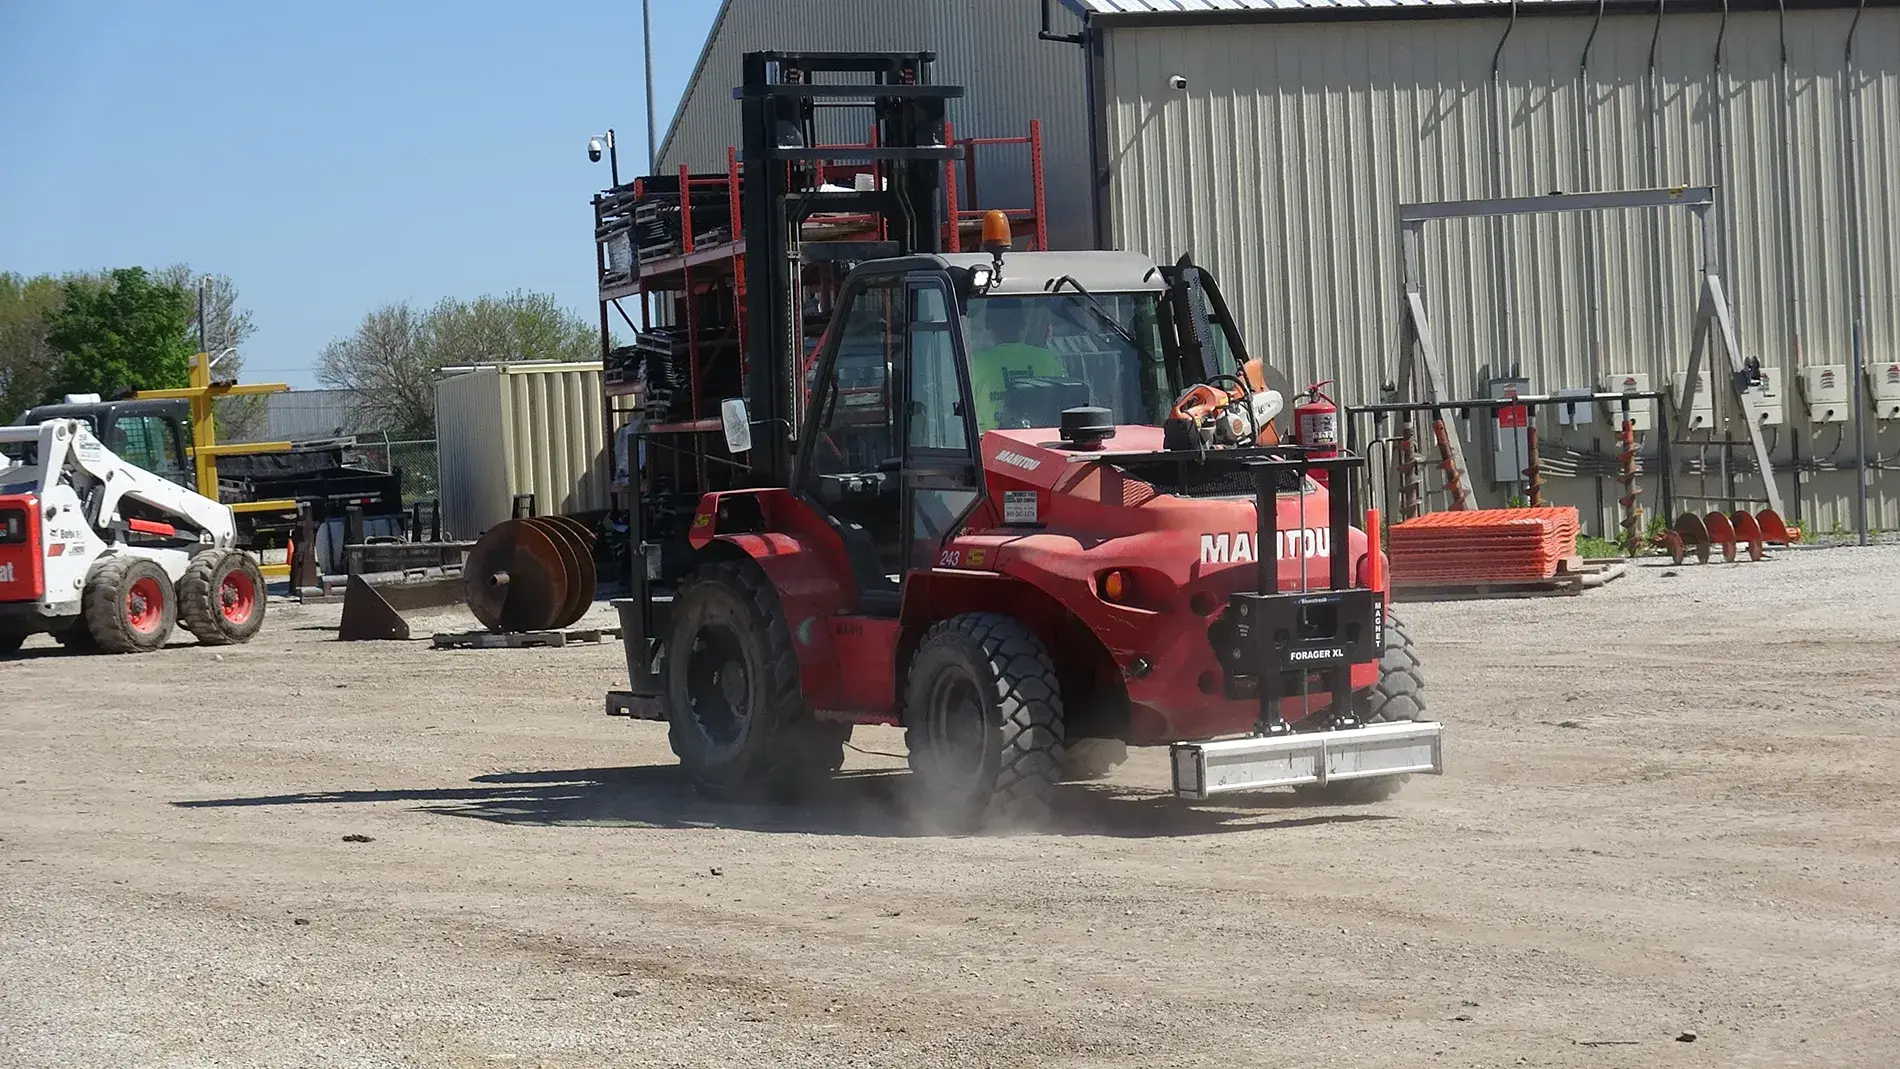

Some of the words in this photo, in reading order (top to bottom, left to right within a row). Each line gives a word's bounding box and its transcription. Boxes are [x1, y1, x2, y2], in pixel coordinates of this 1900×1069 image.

[995, 450, 1041, 470] MANITOU
[1201, 527, 1330, 564] MAITOU
[939, 550, 960, 566] 243
[1374, 602, 1382, 648] MAGNET
[1290, 649, 1331, 661] FORAGER
[1332, 648, 1344, 658] XL
